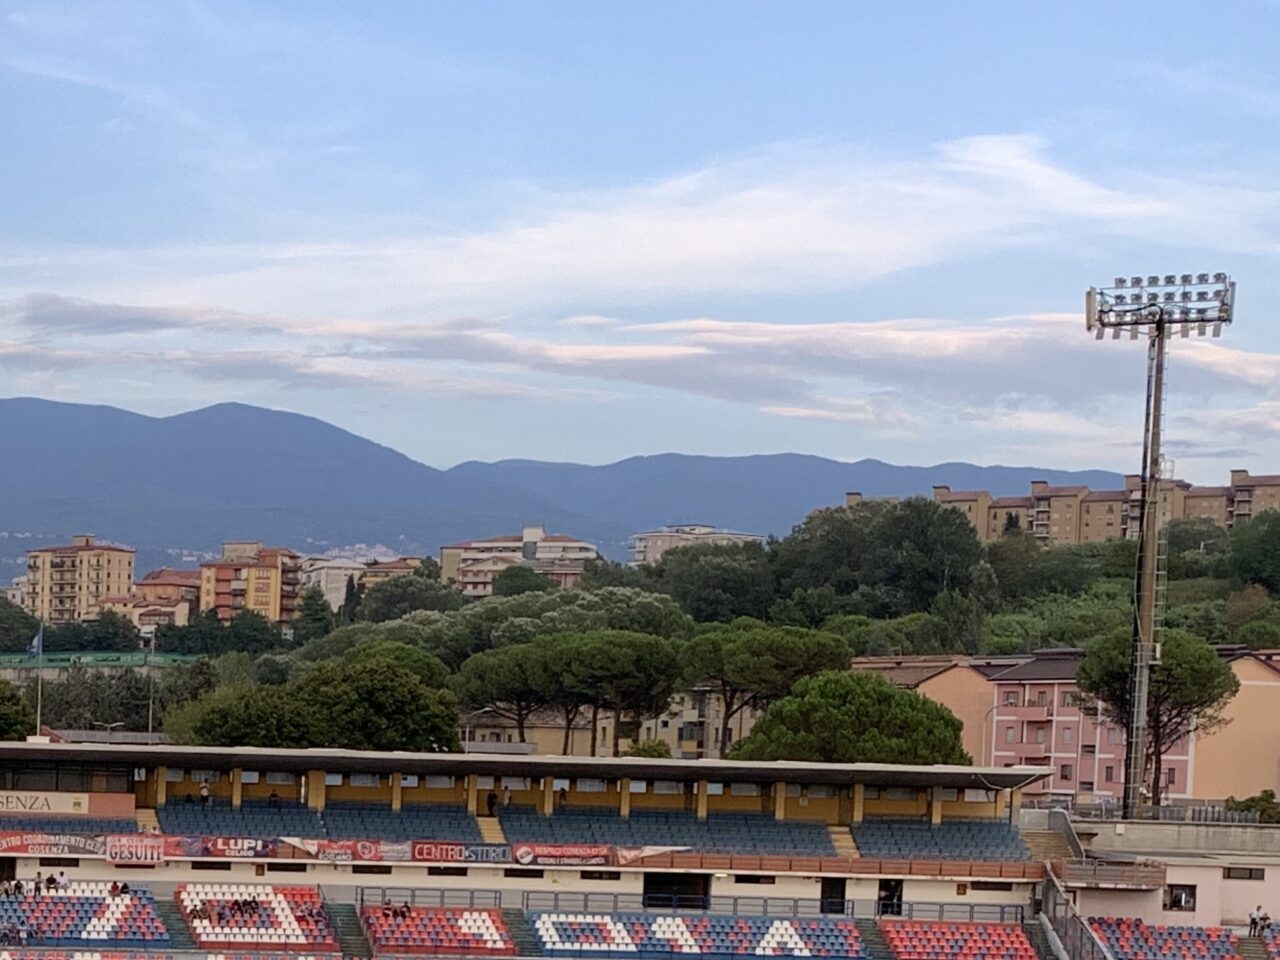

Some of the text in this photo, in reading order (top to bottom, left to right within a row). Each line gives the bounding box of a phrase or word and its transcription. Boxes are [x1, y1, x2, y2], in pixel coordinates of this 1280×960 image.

[28, 844, 70, 855] COSENZA
[216, 838, 263, 851] LUPI
[109, 843, 161, 861] GESUITI
[414, 844, 465, 860] CENTRO
